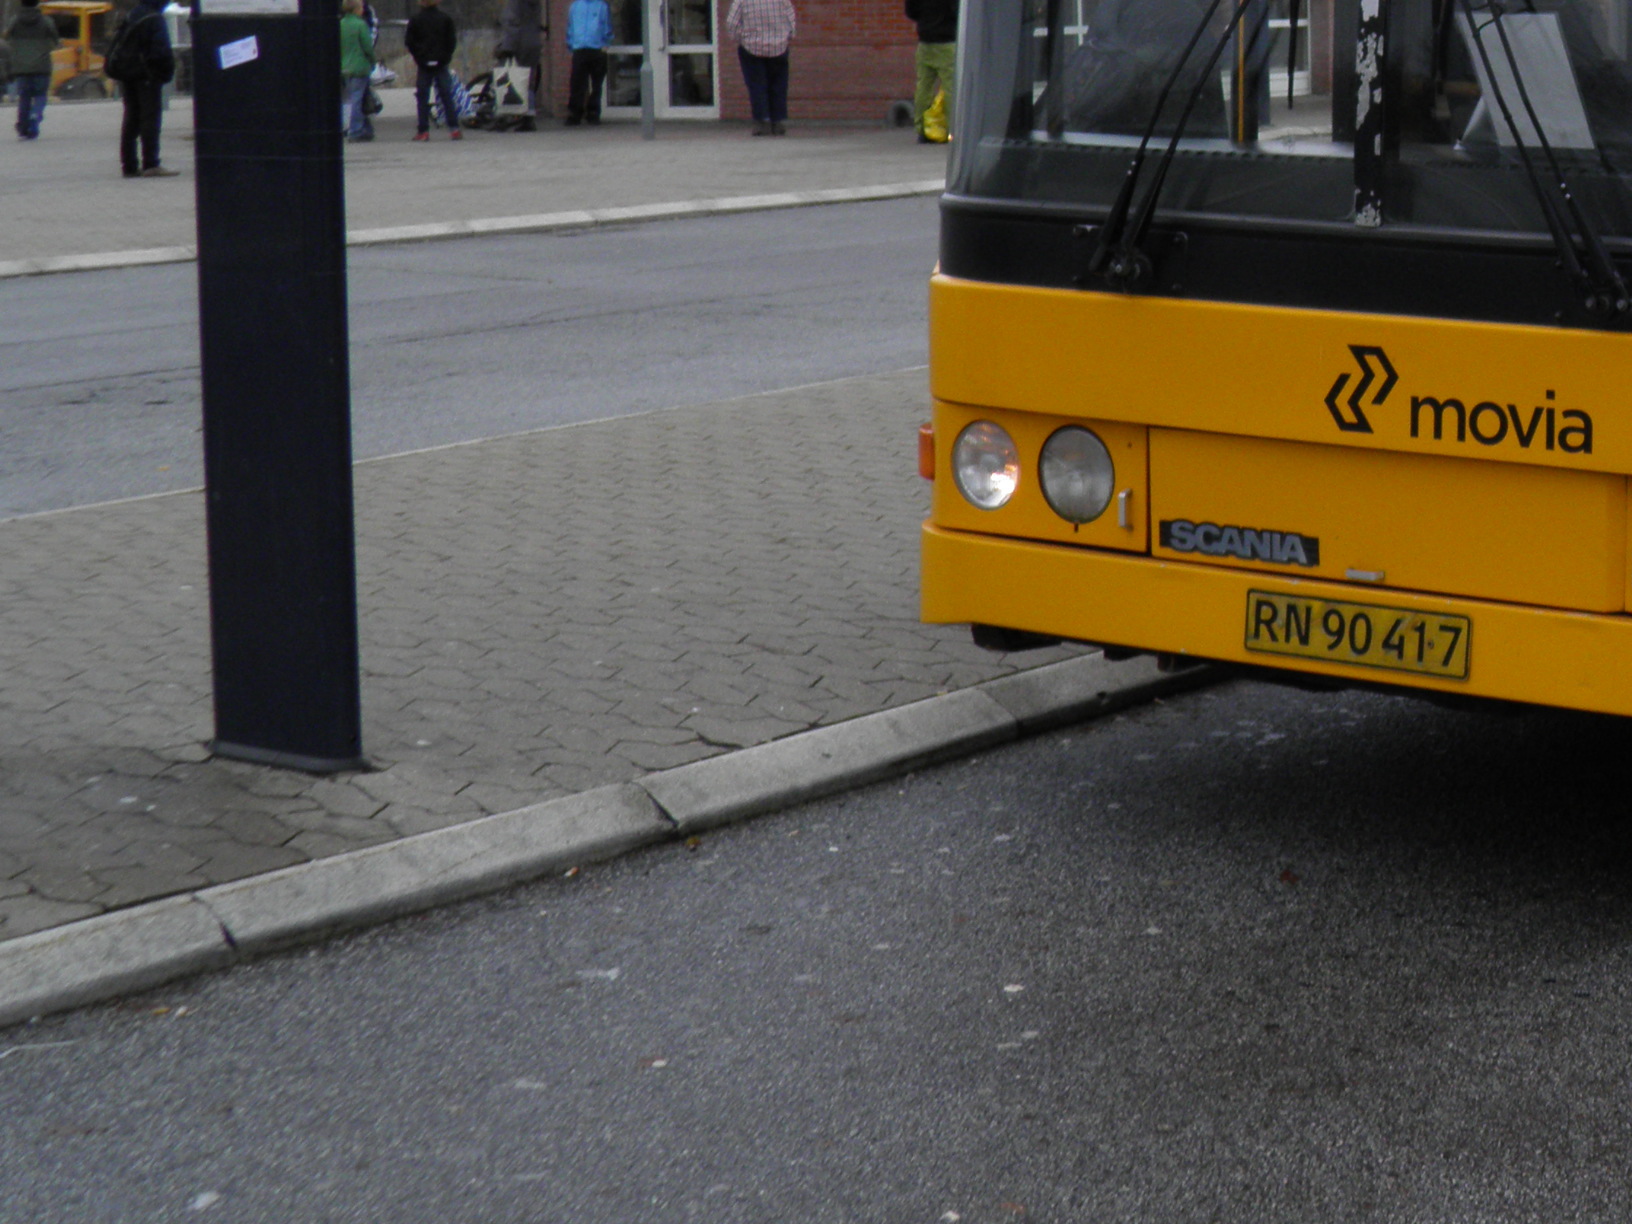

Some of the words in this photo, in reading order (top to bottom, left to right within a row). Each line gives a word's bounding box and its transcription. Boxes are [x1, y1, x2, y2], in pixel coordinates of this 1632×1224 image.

[1409, 390, 1595, 455] movia
[1170, 520, 1308, 564] SCANIA
[1253, 599, 1312, 646] RN
[1322, 609, 1372, 655] 90
[1381, 618, 1462, 667] 417
